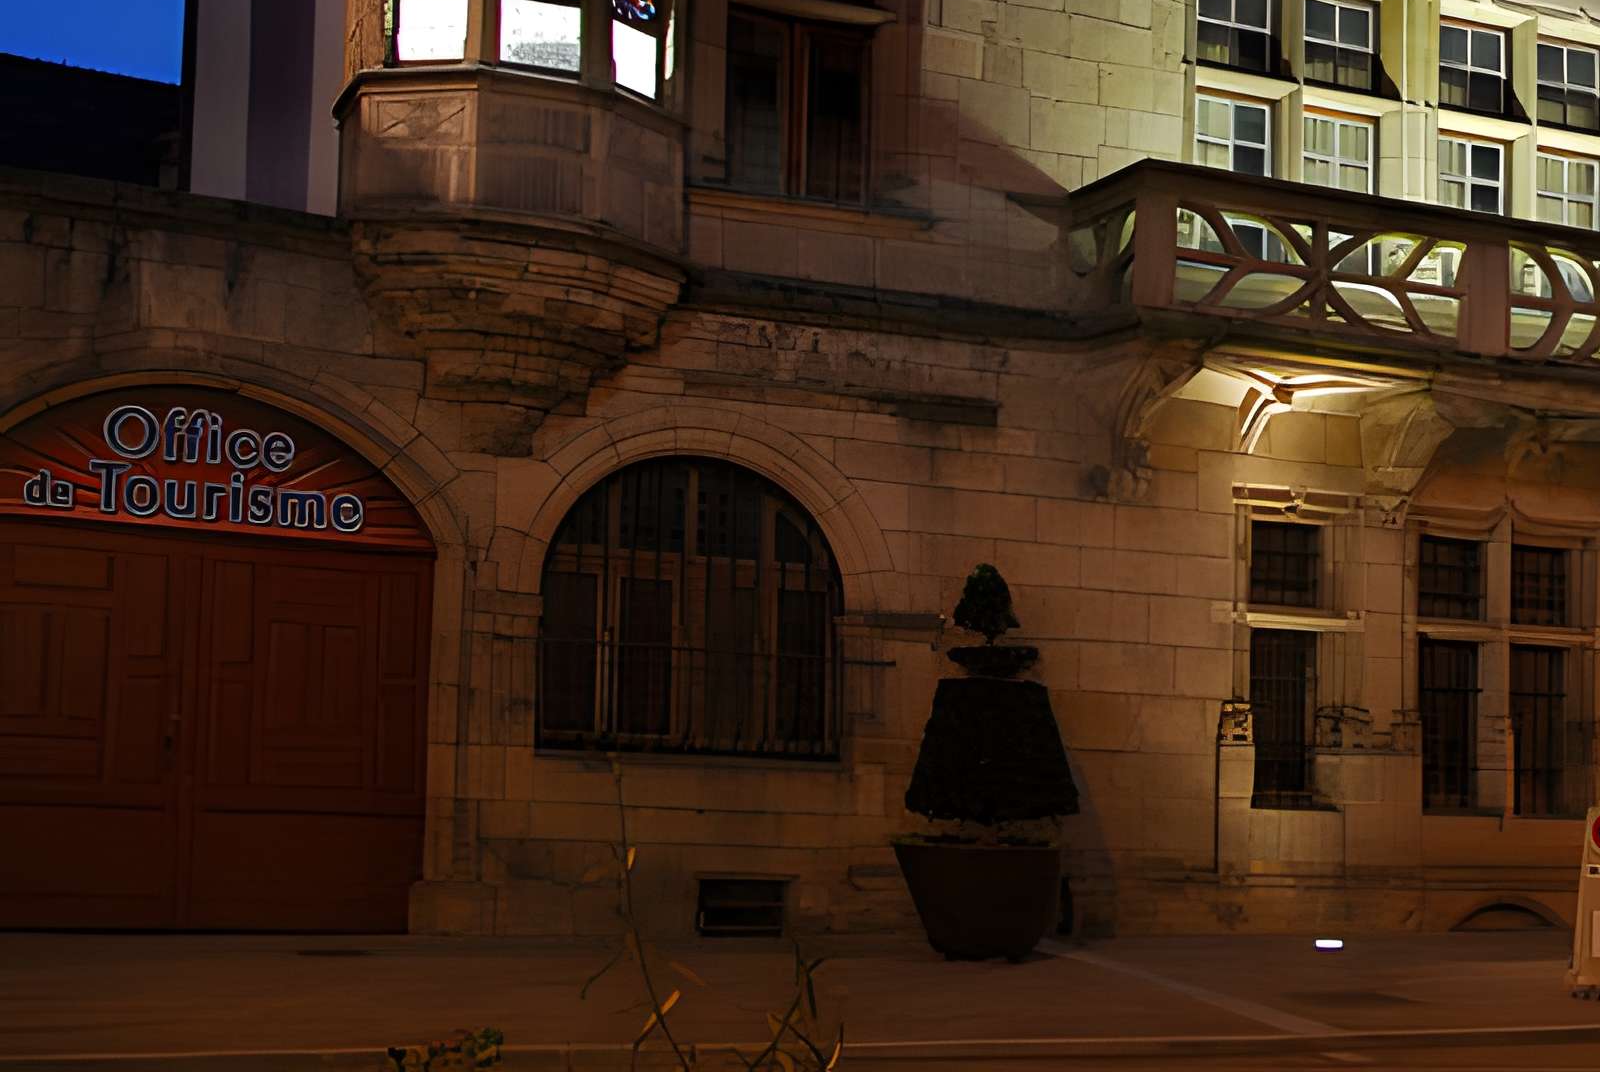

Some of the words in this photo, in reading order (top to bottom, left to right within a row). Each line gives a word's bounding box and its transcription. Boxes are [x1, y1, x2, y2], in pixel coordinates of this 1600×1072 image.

[103, 405, 295, 472] Office
[23, 468, 75, 508] de
[89, 459, 365, 532] Tourisme
